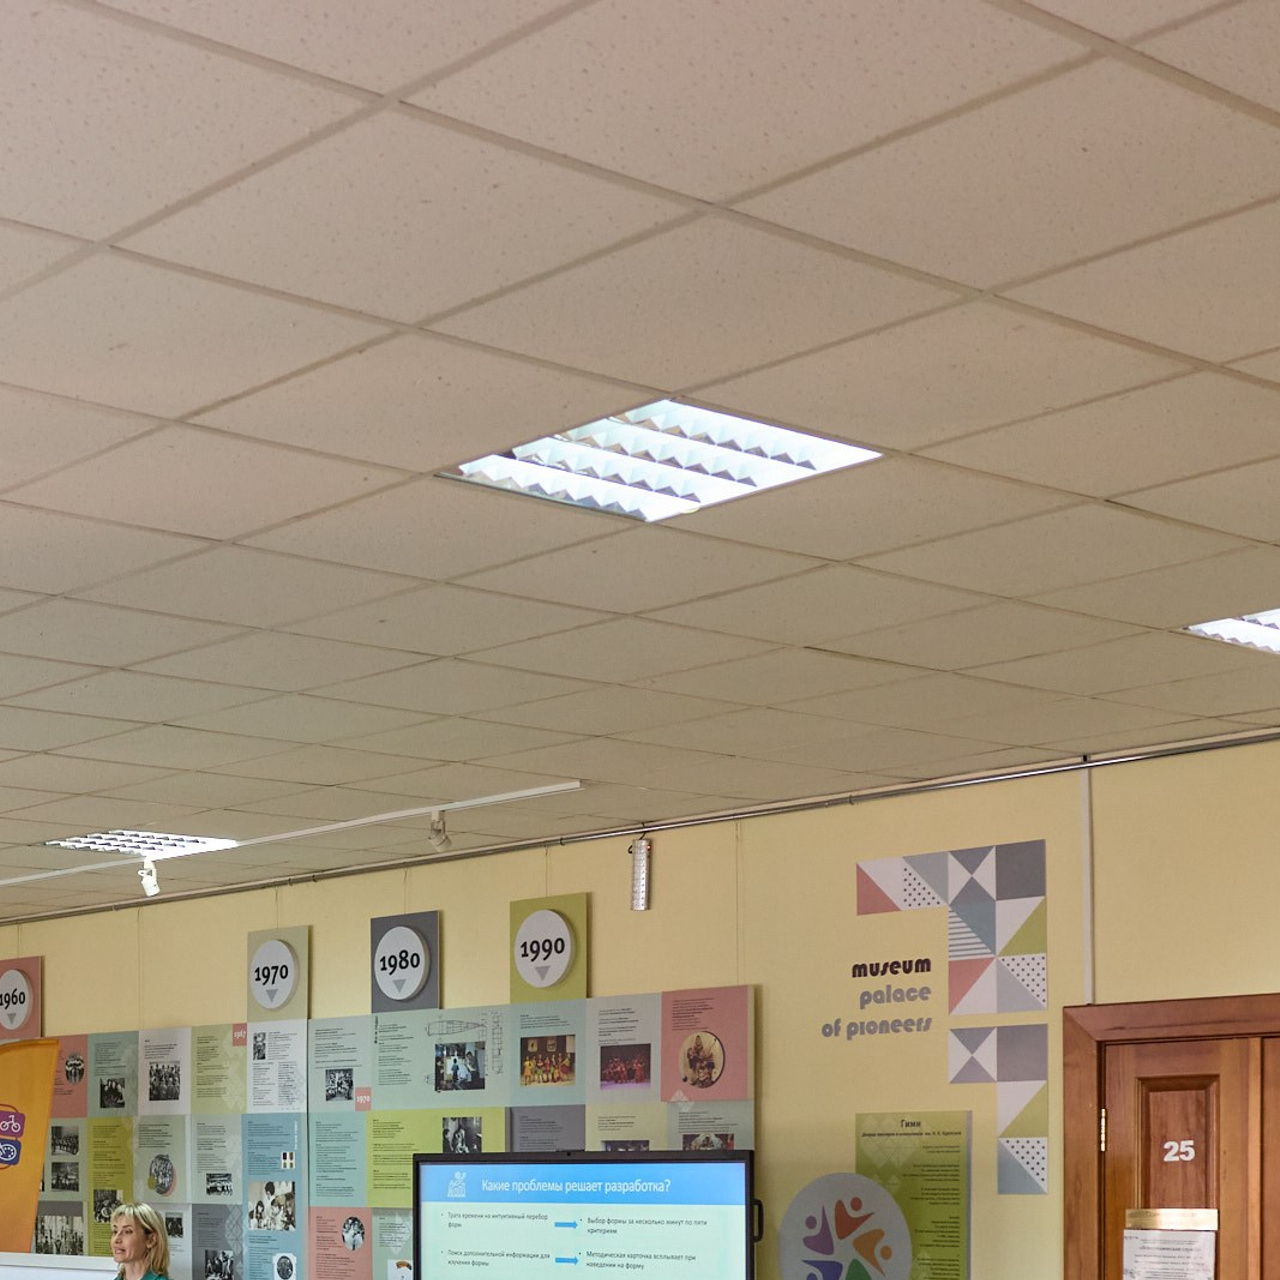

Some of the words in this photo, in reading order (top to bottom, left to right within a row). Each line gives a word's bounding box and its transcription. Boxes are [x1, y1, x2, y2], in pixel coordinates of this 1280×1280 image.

[520, 937, 565, 962] 1990
[379, 949, 420, 976] 1980
[851, 958, 931, 978] museum
[254, 964, 289, 986] 1970
[859, 984, 931, 1010] palace
[821, 1018, 841, 1037] of
[846, 1018, 932, 1040] pioneers
[1163, 1140, 1195, 1162] 25
[482, 1179, 510, 1192] Какие
[512, 1179, 563, 1194] проблемы
[565, 1181, 603, 1194] решает
[605, 1179, 671, 1194] разработка?
[463, 1250, 505, 1258] дополнительной
